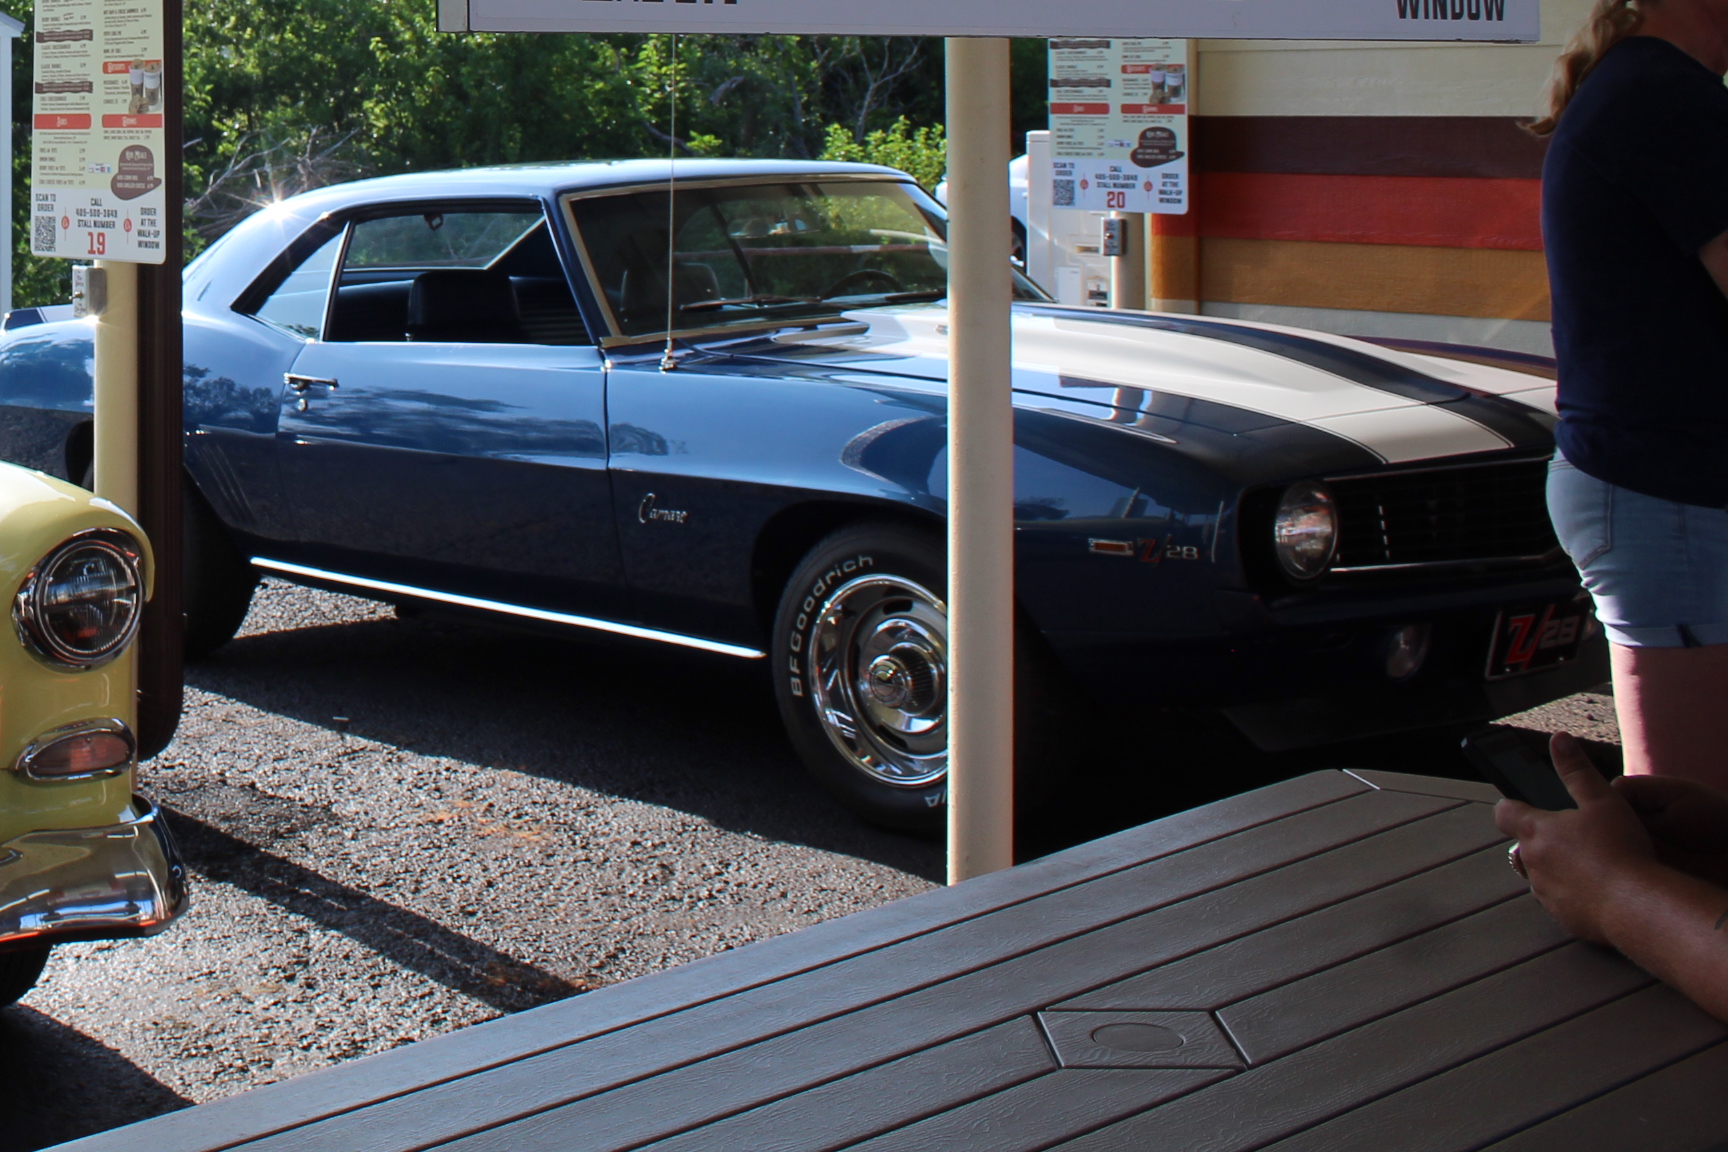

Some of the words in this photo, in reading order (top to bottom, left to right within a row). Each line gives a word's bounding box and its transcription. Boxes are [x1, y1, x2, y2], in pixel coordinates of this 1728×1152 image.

[90, 198, 103, 207] CALL
[1107, 191, 1126, 208] 20
[87, 231, 106, 255] 19
[789, 554, 874, 697] BFGoodrich
